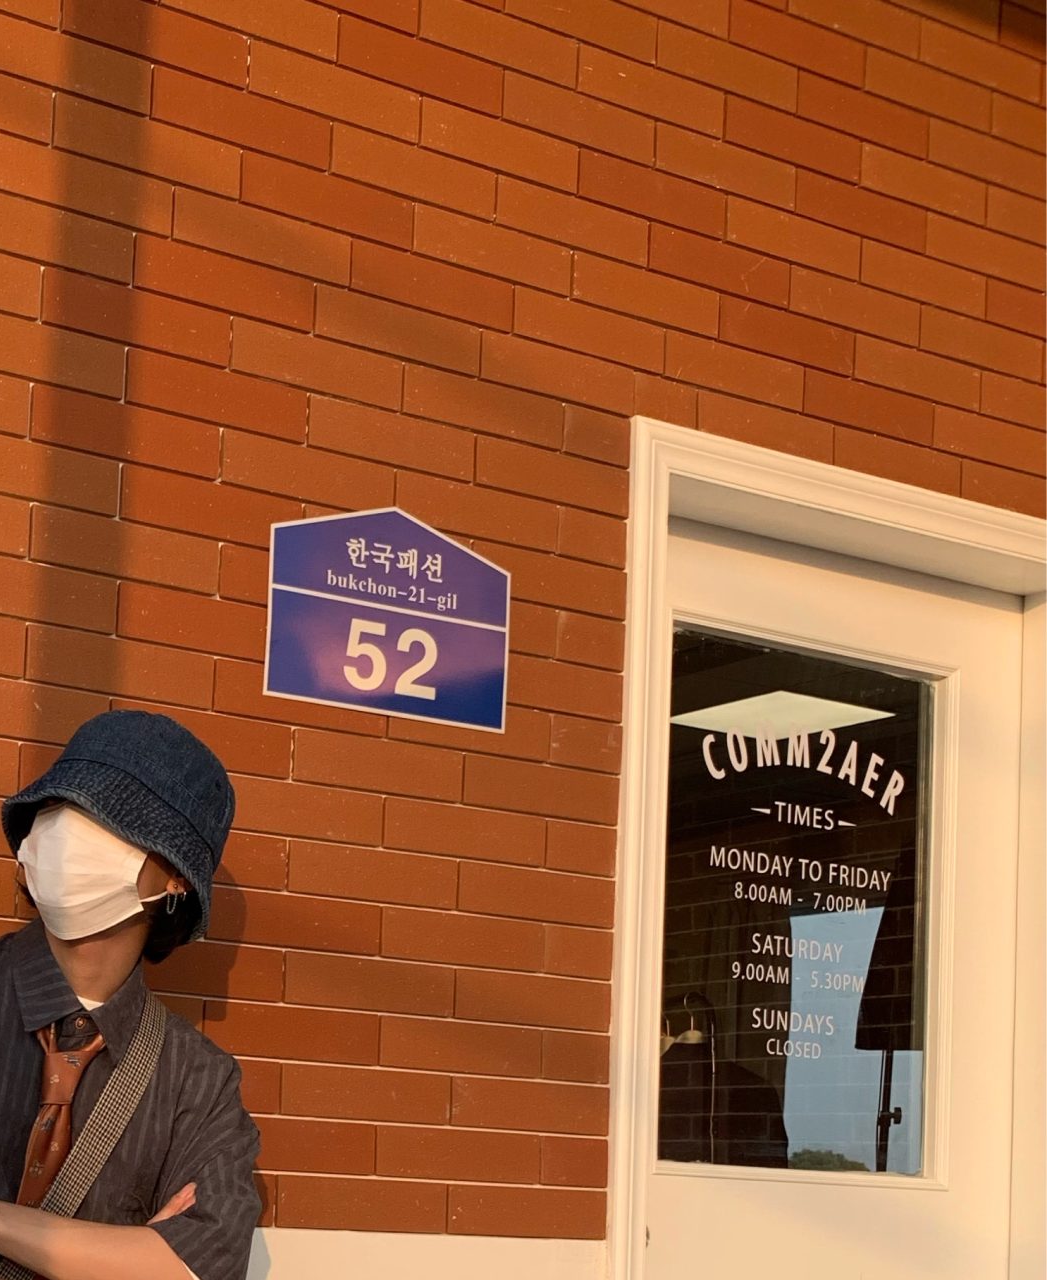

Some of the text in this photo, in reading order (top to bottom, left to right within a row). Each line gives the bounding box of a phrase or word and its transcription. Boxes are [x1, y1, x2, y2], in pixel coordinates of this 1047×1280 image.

[345, 537, 443, 583] 한국패션
[326, 569, 458, 612] bukchon-21-gil
[343, 617, 438, 701] 52
[702, 720, 905, 816] COMM2AER
[774, 801, 835, 830] TIMES
[709, 845, 891, 892] MONDAY TO FRIDAY
[734, 881, 792, 906] 8.00AM
[812, 892, 867, 916] 7.00PM
[751, 932, 844, 964] SATURDAY
[731, 961, 790, 985] 9.00AM
[810, 970, 866, 993] 5.30PM
[751, 1007, 835, 1036] SUNDAYS
[766, 1038, 822, 1059] CLOSED
